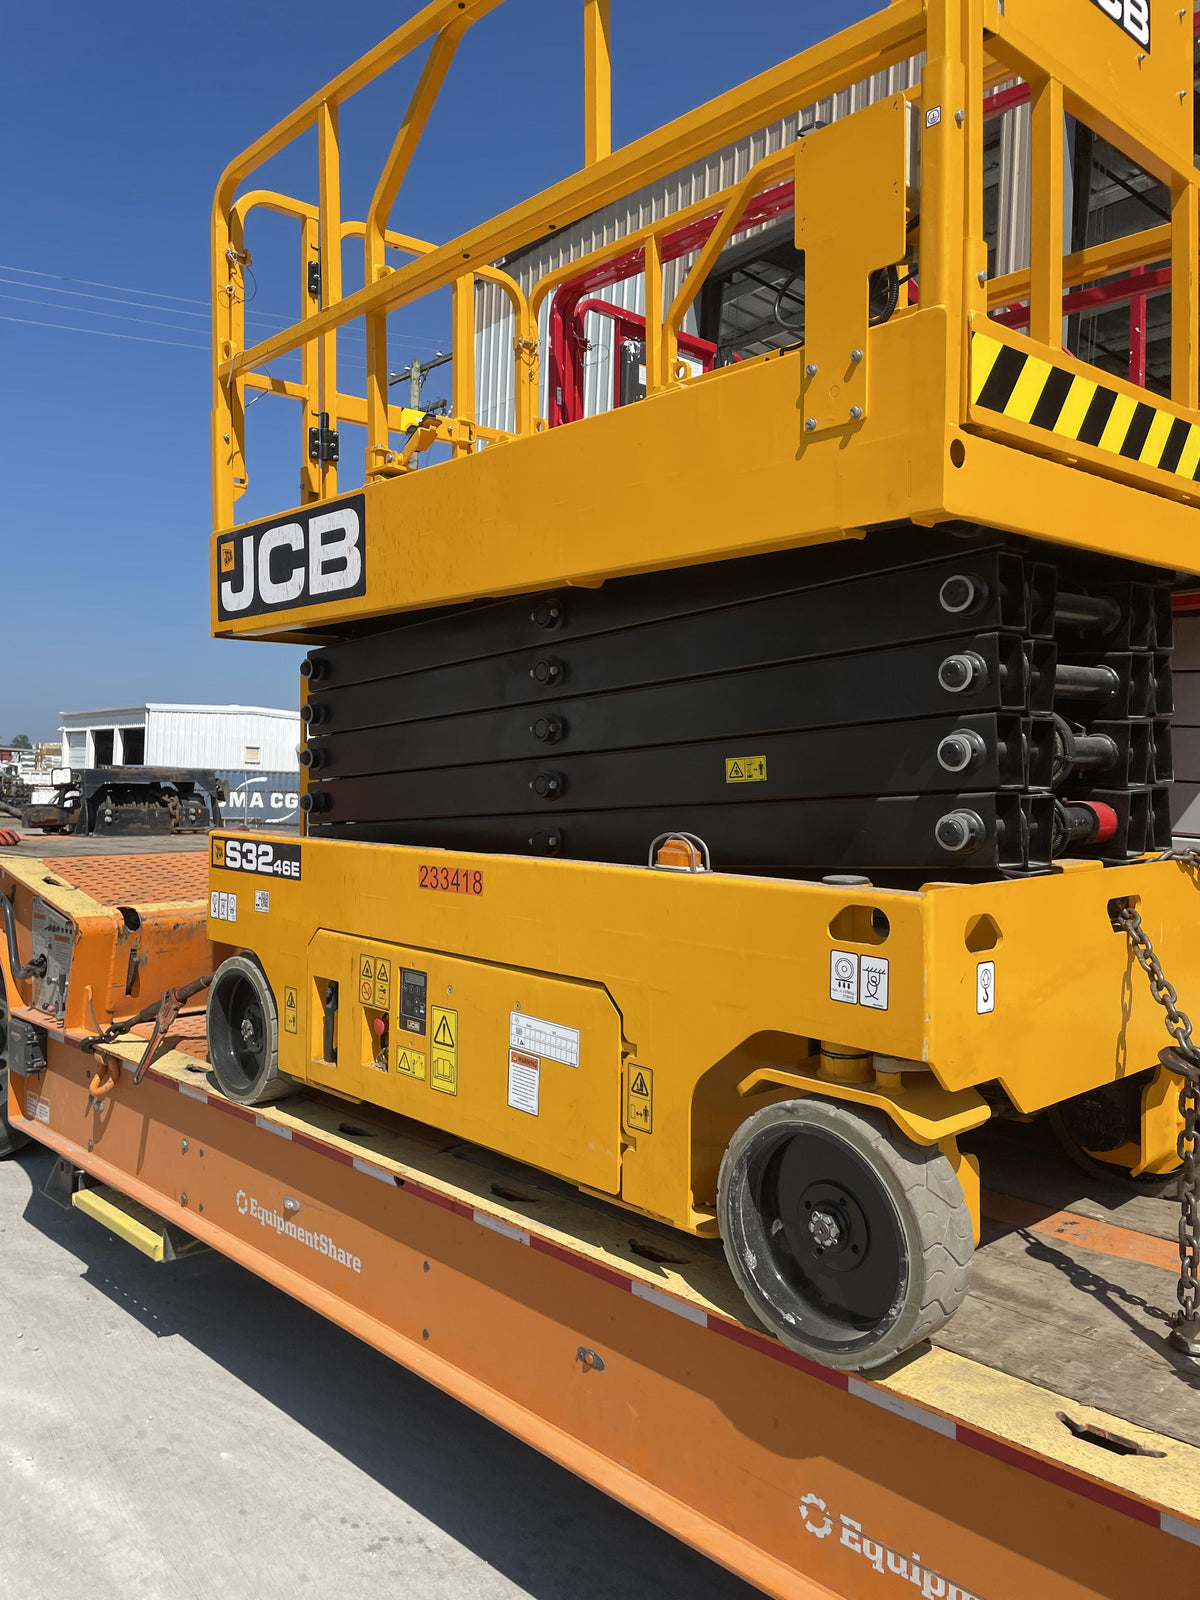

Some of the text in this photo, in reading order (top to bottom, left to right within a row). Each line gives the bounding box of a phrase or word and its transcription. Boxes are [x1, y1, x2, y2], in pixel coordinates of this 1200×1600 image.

[221, 508, 361, 611] JCB
[419, 865, 483, 895] 233418
[249, 1197, 362, 1273] EquipmentShare
